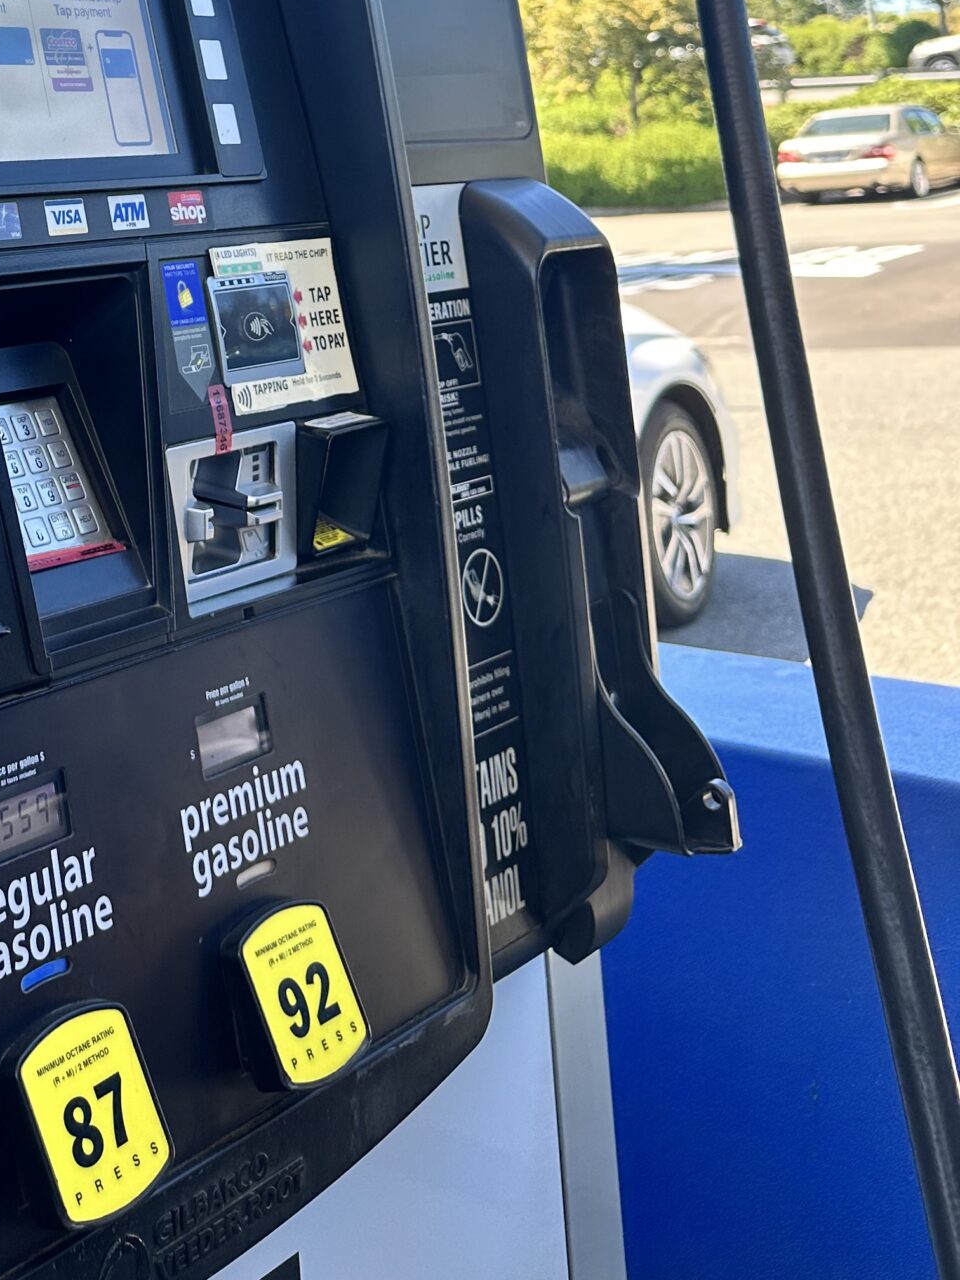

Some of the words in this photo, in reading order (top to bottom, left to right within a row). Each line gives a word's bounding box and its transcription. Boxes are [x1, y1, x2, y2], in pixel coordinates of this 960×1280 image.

[51, 209, 82, 225] VISA
[113, 200, 148, 223] ATM
[170, 202, 207, 225] shop
[214, 251, 220, 260] (4
[221, 249, 233, 259] LED
[234, 248, 257, 258] LIGHTS)
[266, 253, 273, 262] IT
[274, 251, 294, 261] READ
[295, 249, 309, 259] THE
[309, 248, 329, 258] CHIP!
[308, 286, 331, 303] TAP
[309, 308, 341, 327] HERE
[312, 335, 327, 352] TO
[328, 332, 346, 349] PAY
[252, 379, 289, 395] TAPPING
[180, 759, 307, 853] premium
[491, 801, 528, 861] 10%
[193, 805, 310, 898] gasoline
[277, 961, 342, 1039] 92
[36, 1055, 66, 1077] MINIMUM
[66, 1039, 92, 1061] OCTANE
[92, 1026, 115, 1045] RATING
[290, 1021, 358, 1070] PRESS
[63, 1071, 129, 1168] 87
[75, 1142, 159, 1206] PRESS
